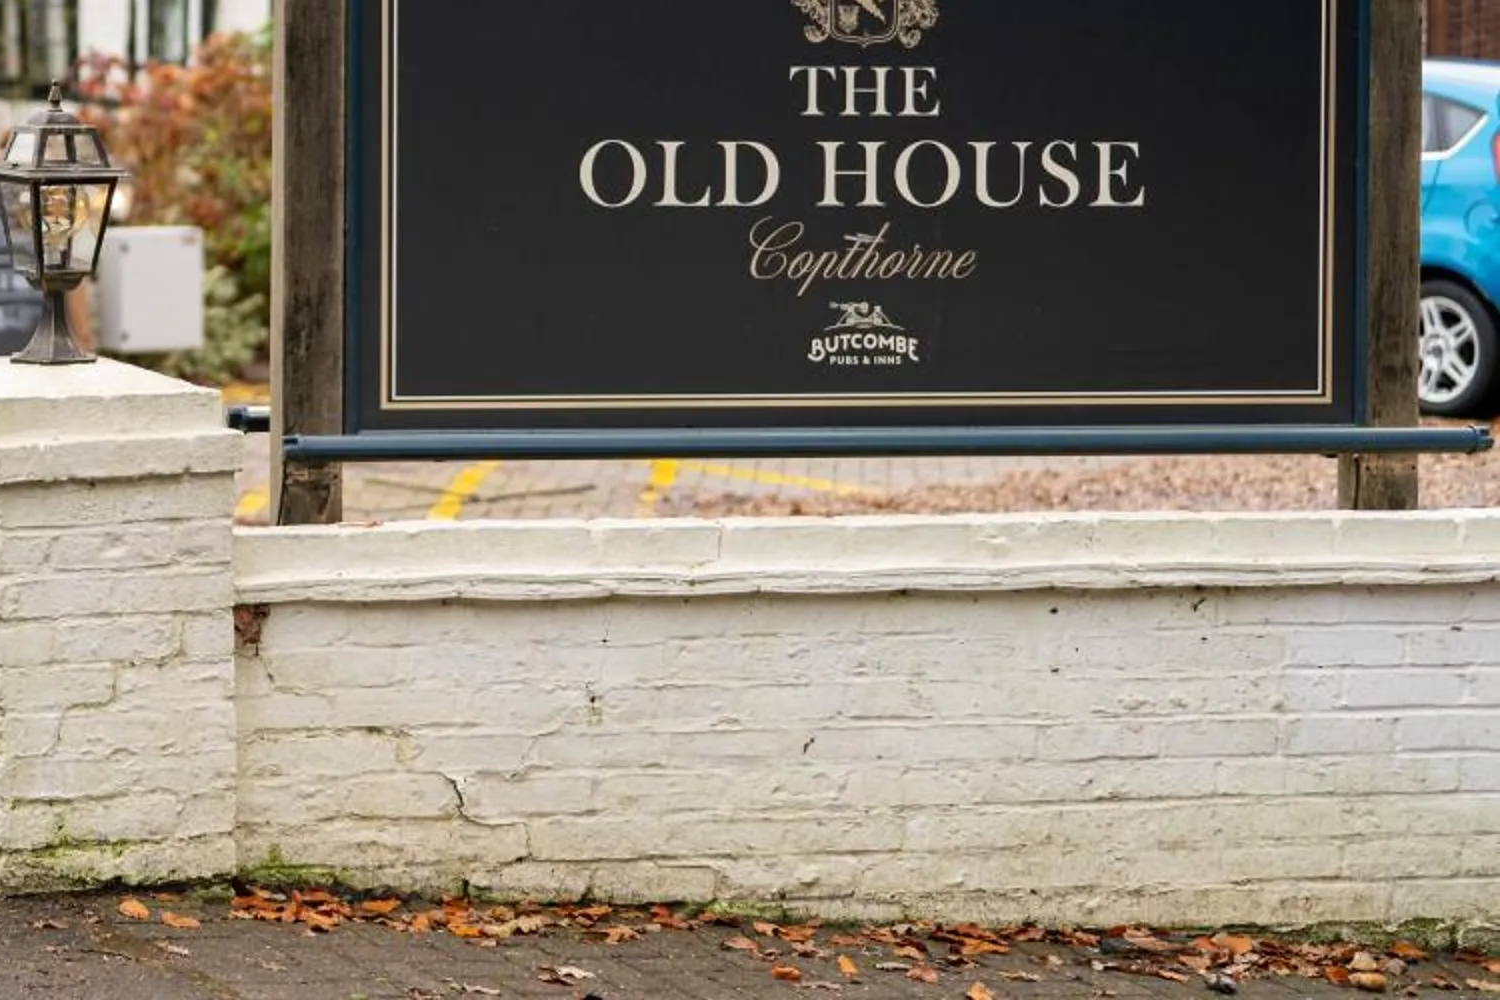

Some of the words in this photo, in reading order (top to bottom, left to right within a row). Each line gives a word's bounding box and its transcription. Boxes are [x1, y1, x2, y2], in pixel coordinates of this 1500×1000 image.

[789, 66, 940, 117] THE
[579, 139, 781, 208] OLD
[815, 139, 1146, 208] HOUSE
[749, 215, 978, 297] Copthorne
[807, 333, 919, 362] BUTCOMBE
[829, 355, 859, 365] PUBS
[873, 355, 901, 365] INNS
